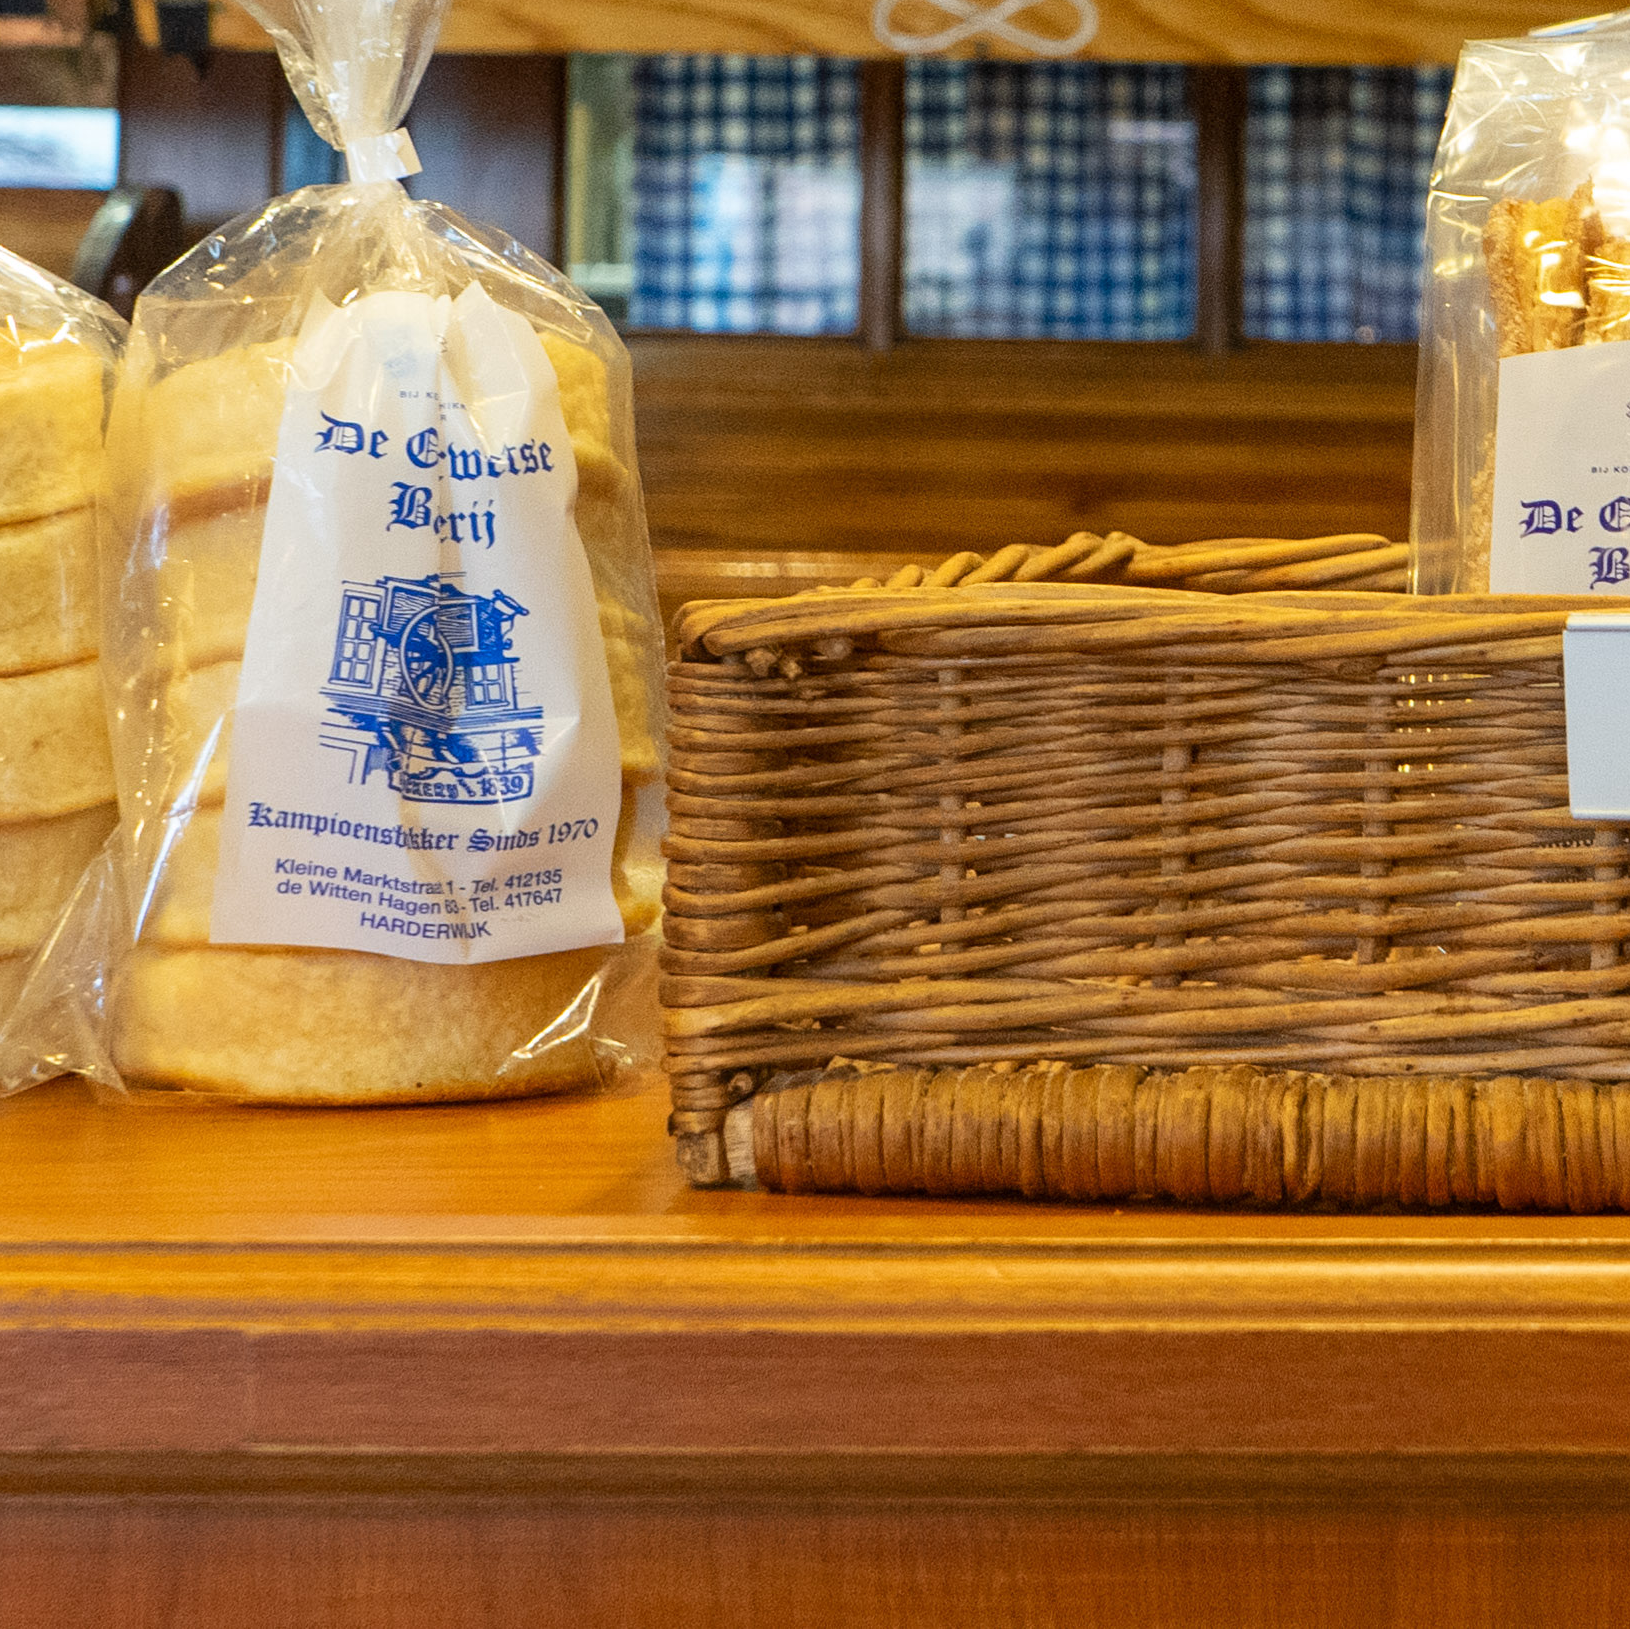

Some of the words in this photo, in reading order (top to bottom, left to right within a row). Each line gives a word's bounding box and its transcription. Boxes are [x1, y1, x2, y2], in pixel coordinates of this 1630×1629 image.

[314, 410, 389, 459] De
[1519, 499, 1584, 539] De
[466, 826, 541, 853] Sinds
[547, 817, 599, 845] 1970
[275, 857, 338, 880] Kleine
[472, 877, 499, 895] Tel.
[504, 869, 563, 890] 412135
[276, 878, 302, 896] de
[308, 882, 372, 905] Witten
[377, 892, 441, 916] Hagen
[469, 896, 499, 913] Tel.
[503, 889, 562, 909] 417647
